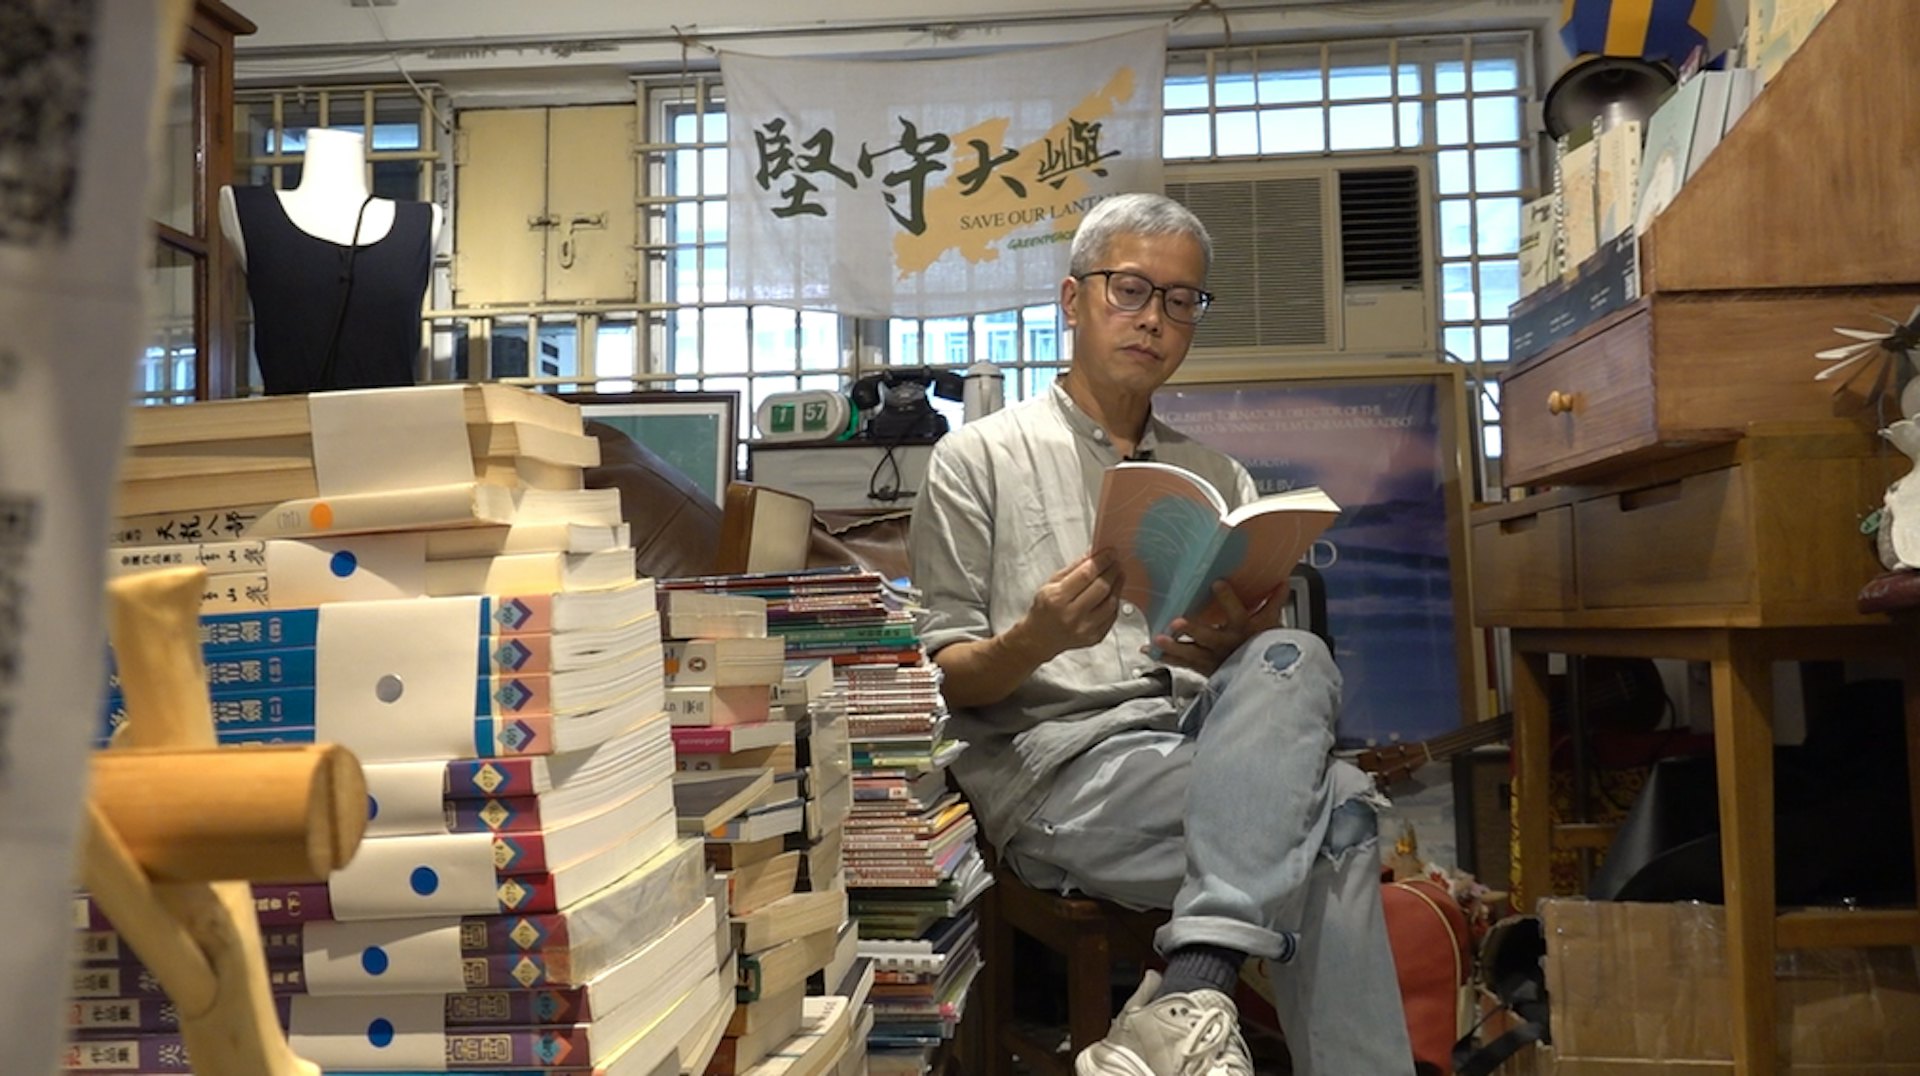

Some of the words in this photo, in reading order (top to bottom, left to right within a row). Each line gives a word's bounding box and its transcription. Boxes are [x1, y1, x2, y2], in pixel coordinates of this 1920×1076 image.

[754, 116, 1120, 236] 堅守大嶼
[960, 212, 1005, 230] SAVE
[1007, 207, 1045, 224] OUR
[805, 403, 826, 421] 57
